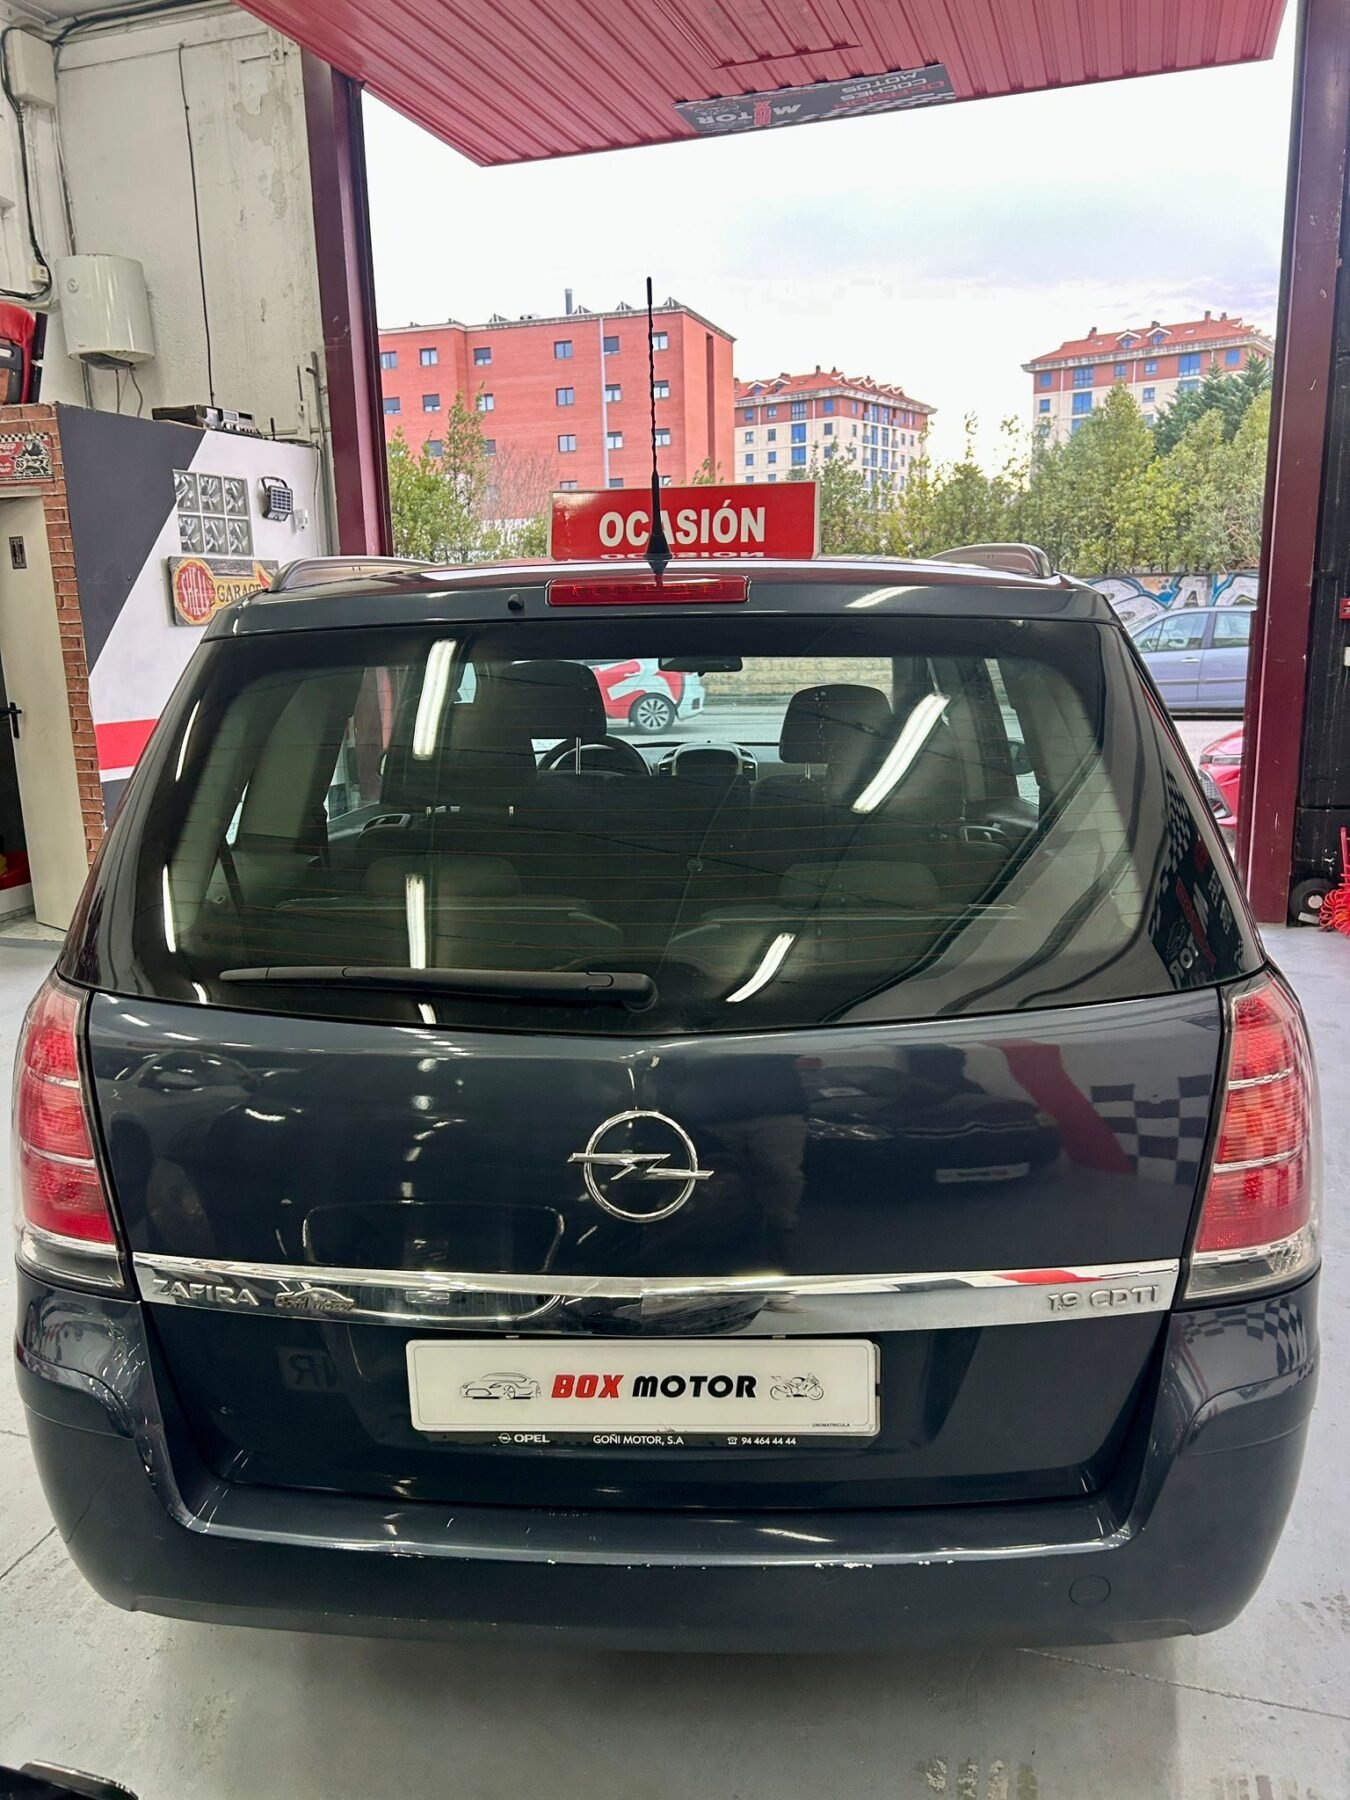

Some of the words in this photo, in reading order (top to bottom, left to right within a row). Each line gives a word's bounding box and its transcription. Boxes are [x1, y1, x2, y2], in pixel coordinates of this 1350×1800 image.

[153, 1278, 259, 1307] ZAFIRA
[1089, 1285, 1160, 1308] CDTI
[551, 1374, 625, 1398] BOX
[632, 1374, 757, 1398] MOTOR
[514, 1433, 550, 1444] OPEL
[593, 1433, 621, 1444] GOÑI
[622, 1435, 665, 1446] MOTOR,
[667, 1435, 684, 1445] S.A
[741, 1436, 752, 1445] 94
[753, 1436, 770, 1445] 464
[772, 1437, 783, 1445] 44
[785, 1437, 797, 1446] 44
